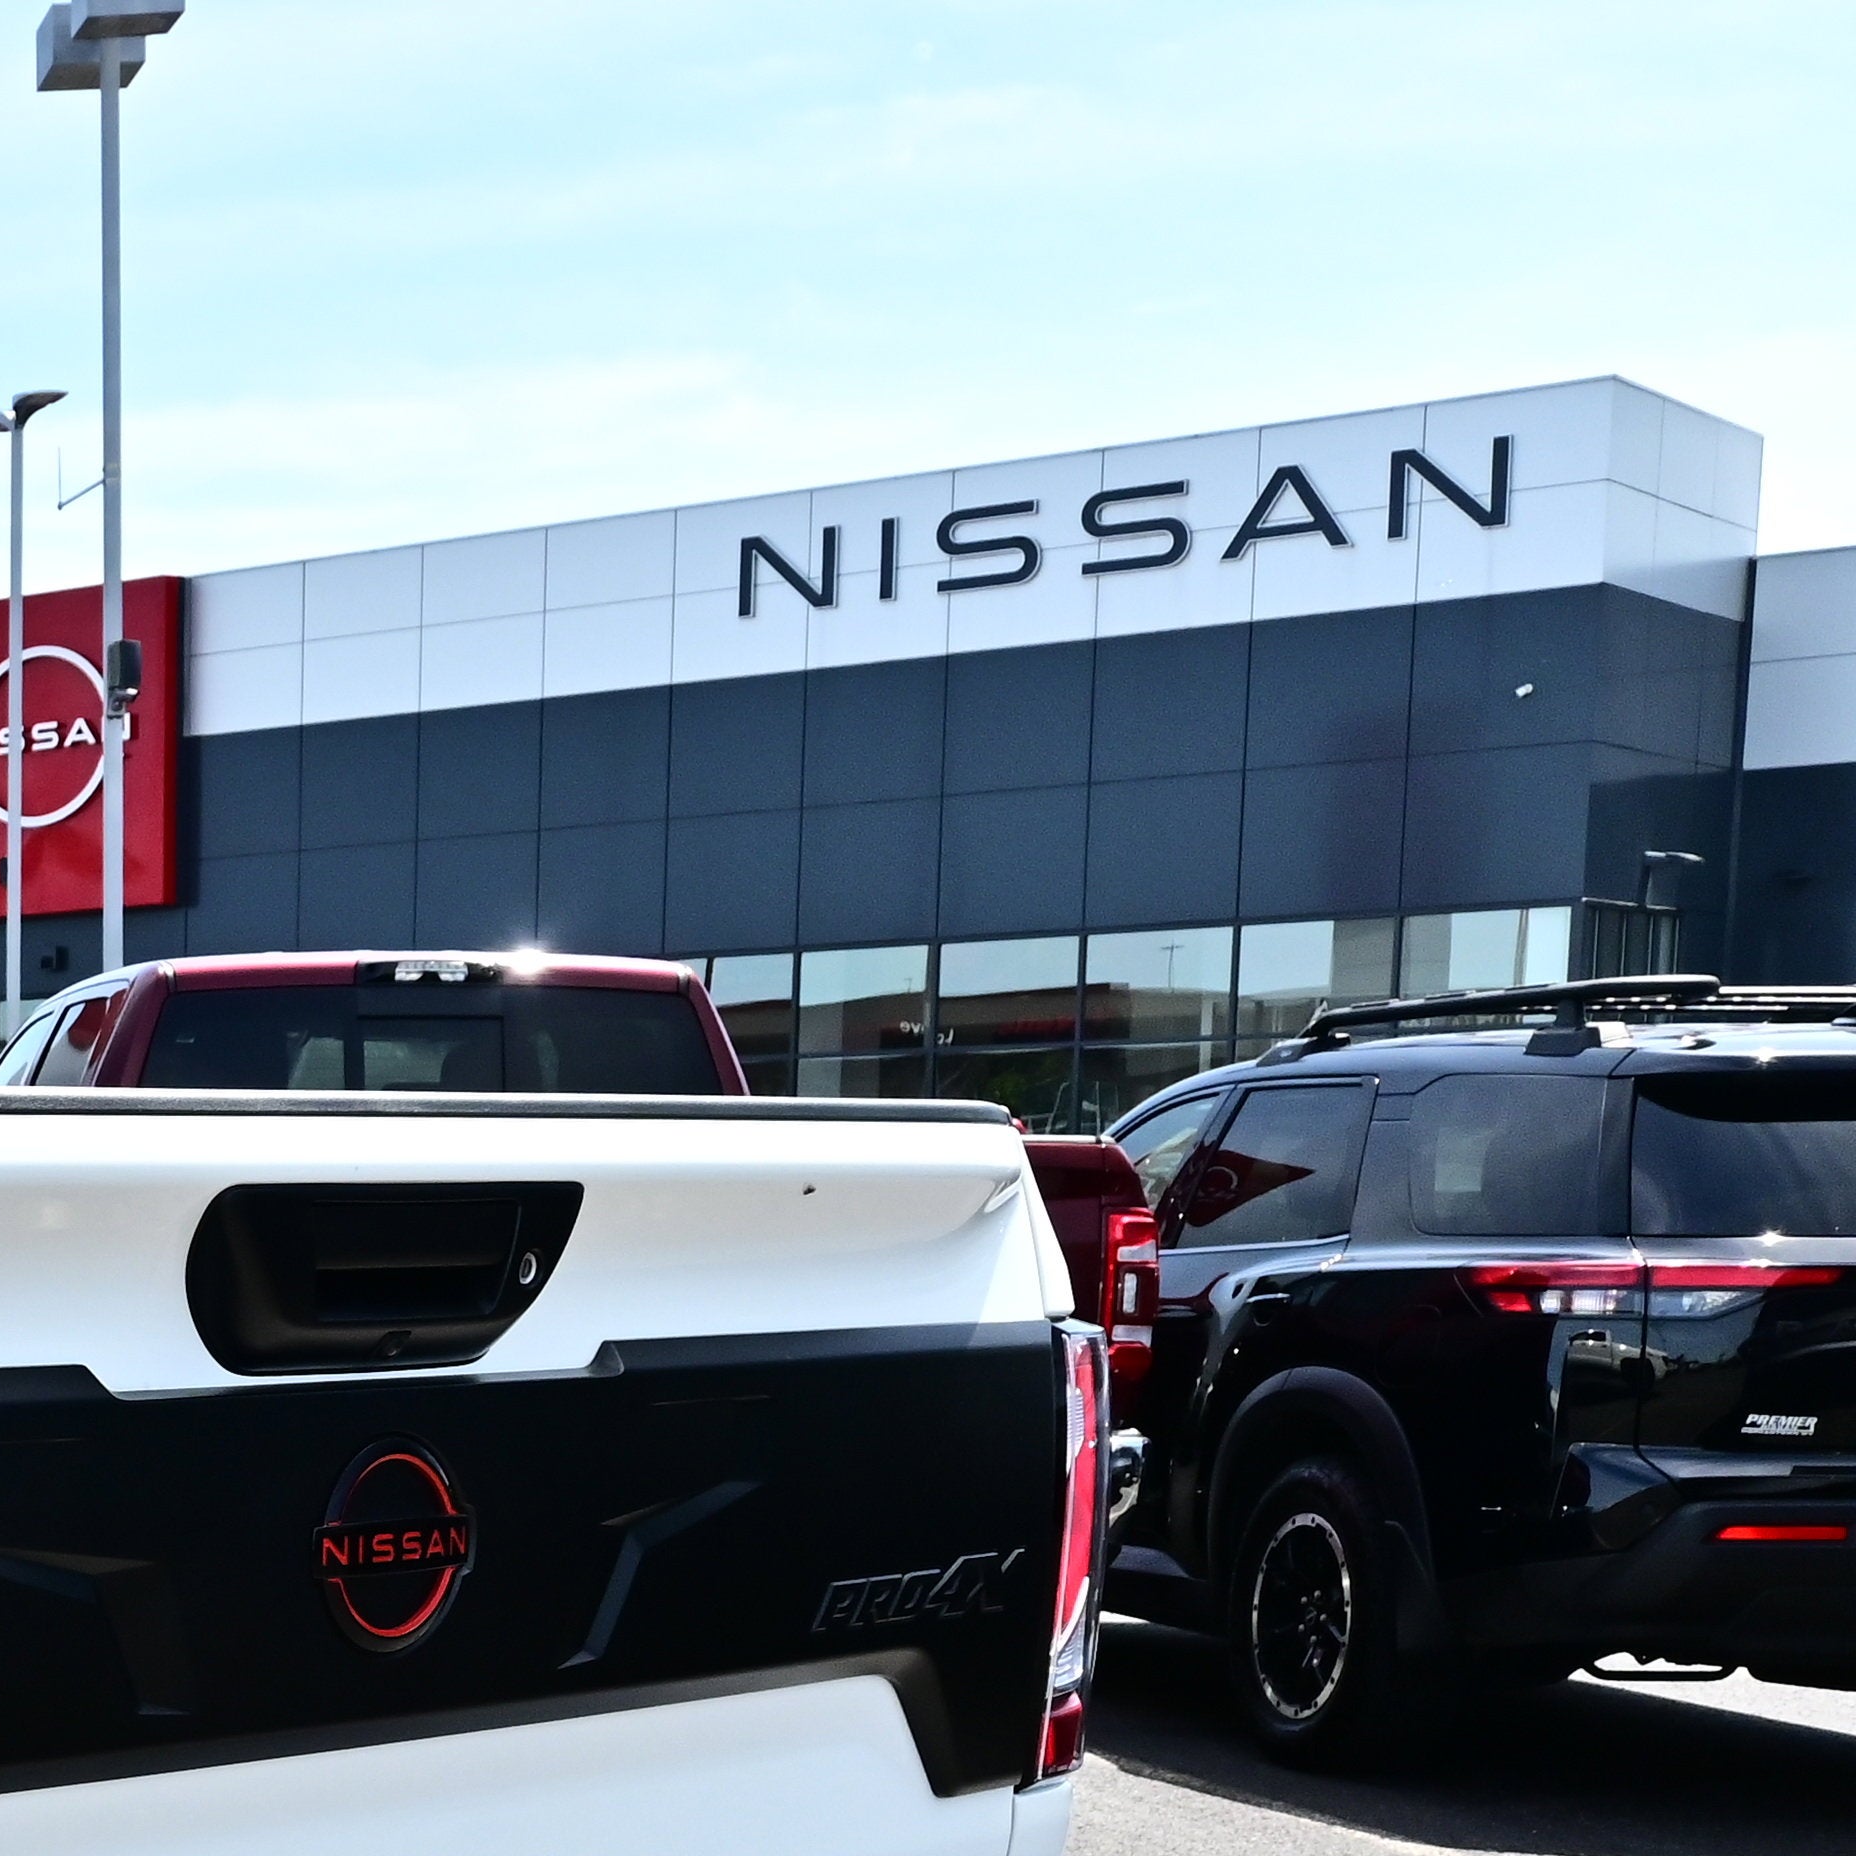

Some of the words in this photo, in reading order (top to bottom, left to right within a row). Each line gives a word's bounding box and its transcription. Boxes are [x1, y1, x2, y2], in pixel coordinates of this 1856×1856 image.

[737, 433, 1515, 619] NISSAN
[1745, 1413, 1818, 1429] PREMIER
[321, 1525, 467, 1567] NISSAN
